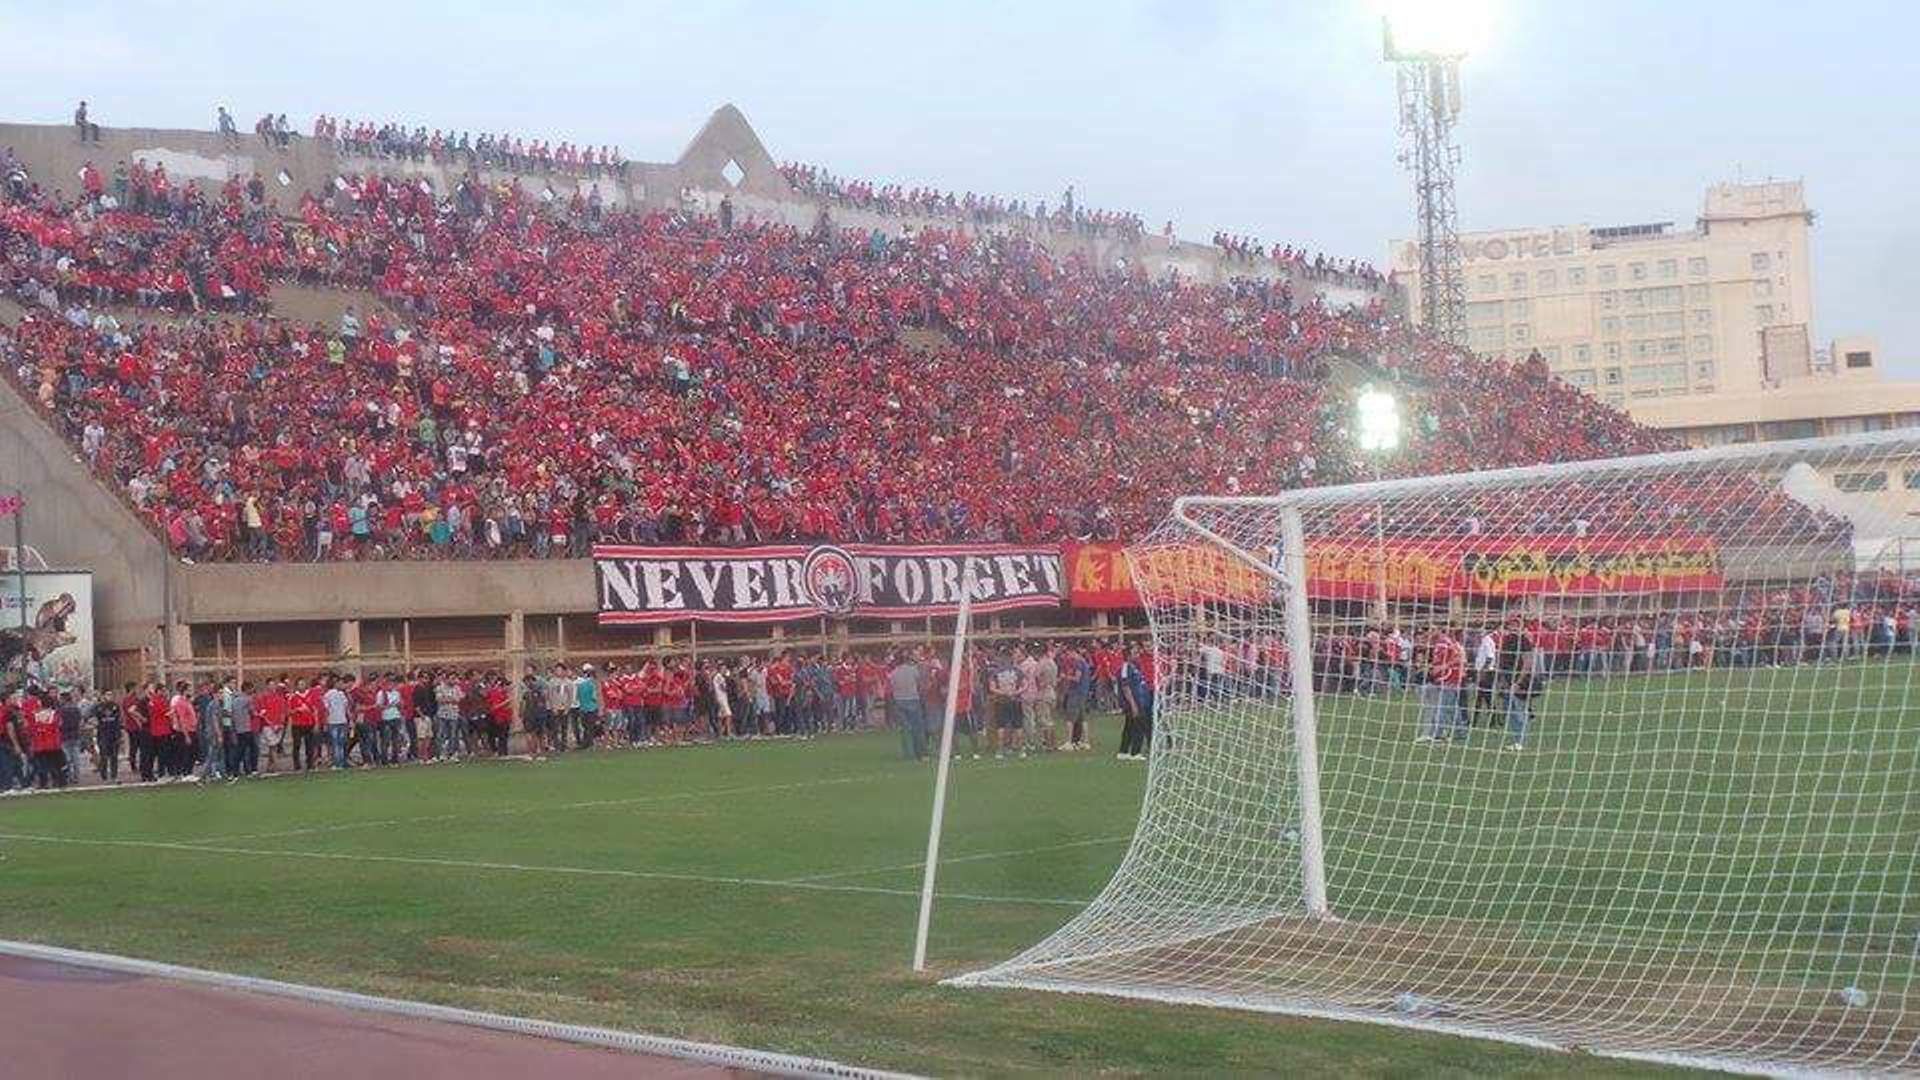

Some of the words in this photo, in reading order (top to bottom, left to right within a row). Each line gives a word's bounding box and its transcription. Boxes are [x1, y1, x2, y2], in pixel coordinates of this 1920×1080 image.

[1402, 228, 1575, 262] VOTEL
[597, 559, 813, 610] NEVER
[855, 554, 1060, 603] FORGET
